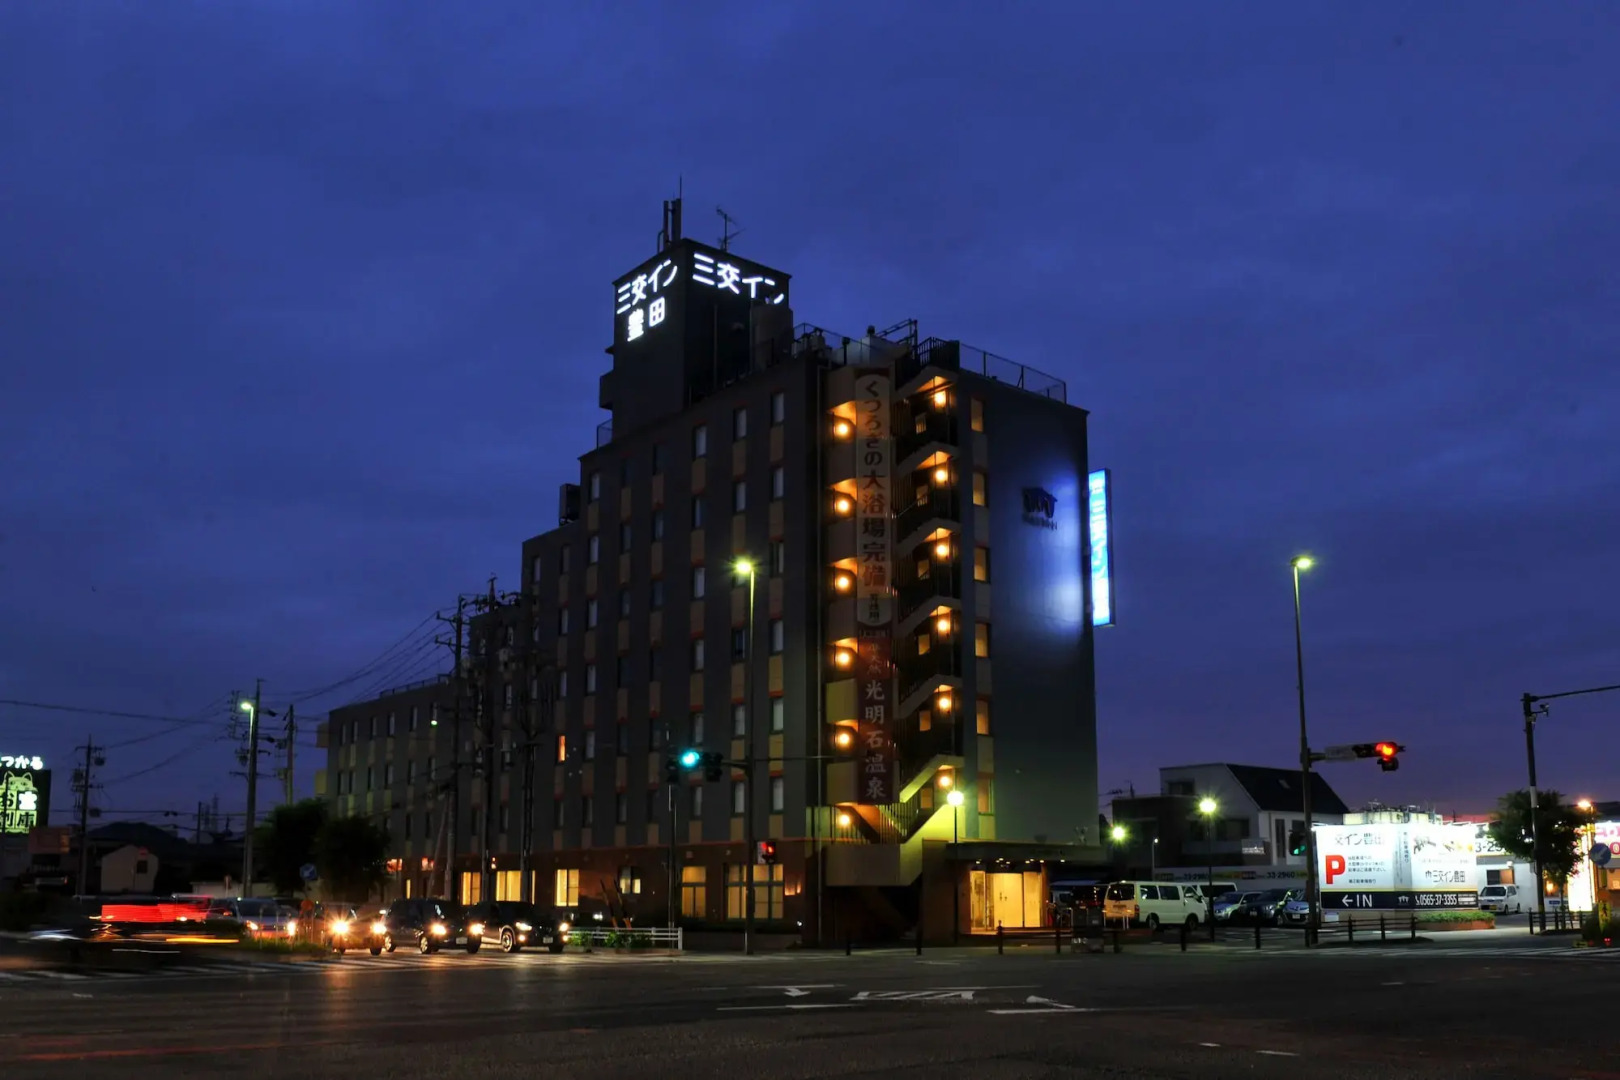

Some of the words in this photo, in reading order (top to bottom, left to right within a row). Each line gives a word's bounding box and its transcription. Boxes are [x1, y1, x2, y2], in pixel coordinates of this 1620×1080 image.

[617, 259, 678, 314] 三交イン
[627, 296, 666, 342] 豊田
[1325, 855, 1345, 885] P
[1356, 894, 1373, 907] IN
[1419, 894, 1457, 906] 0565-37-3355
